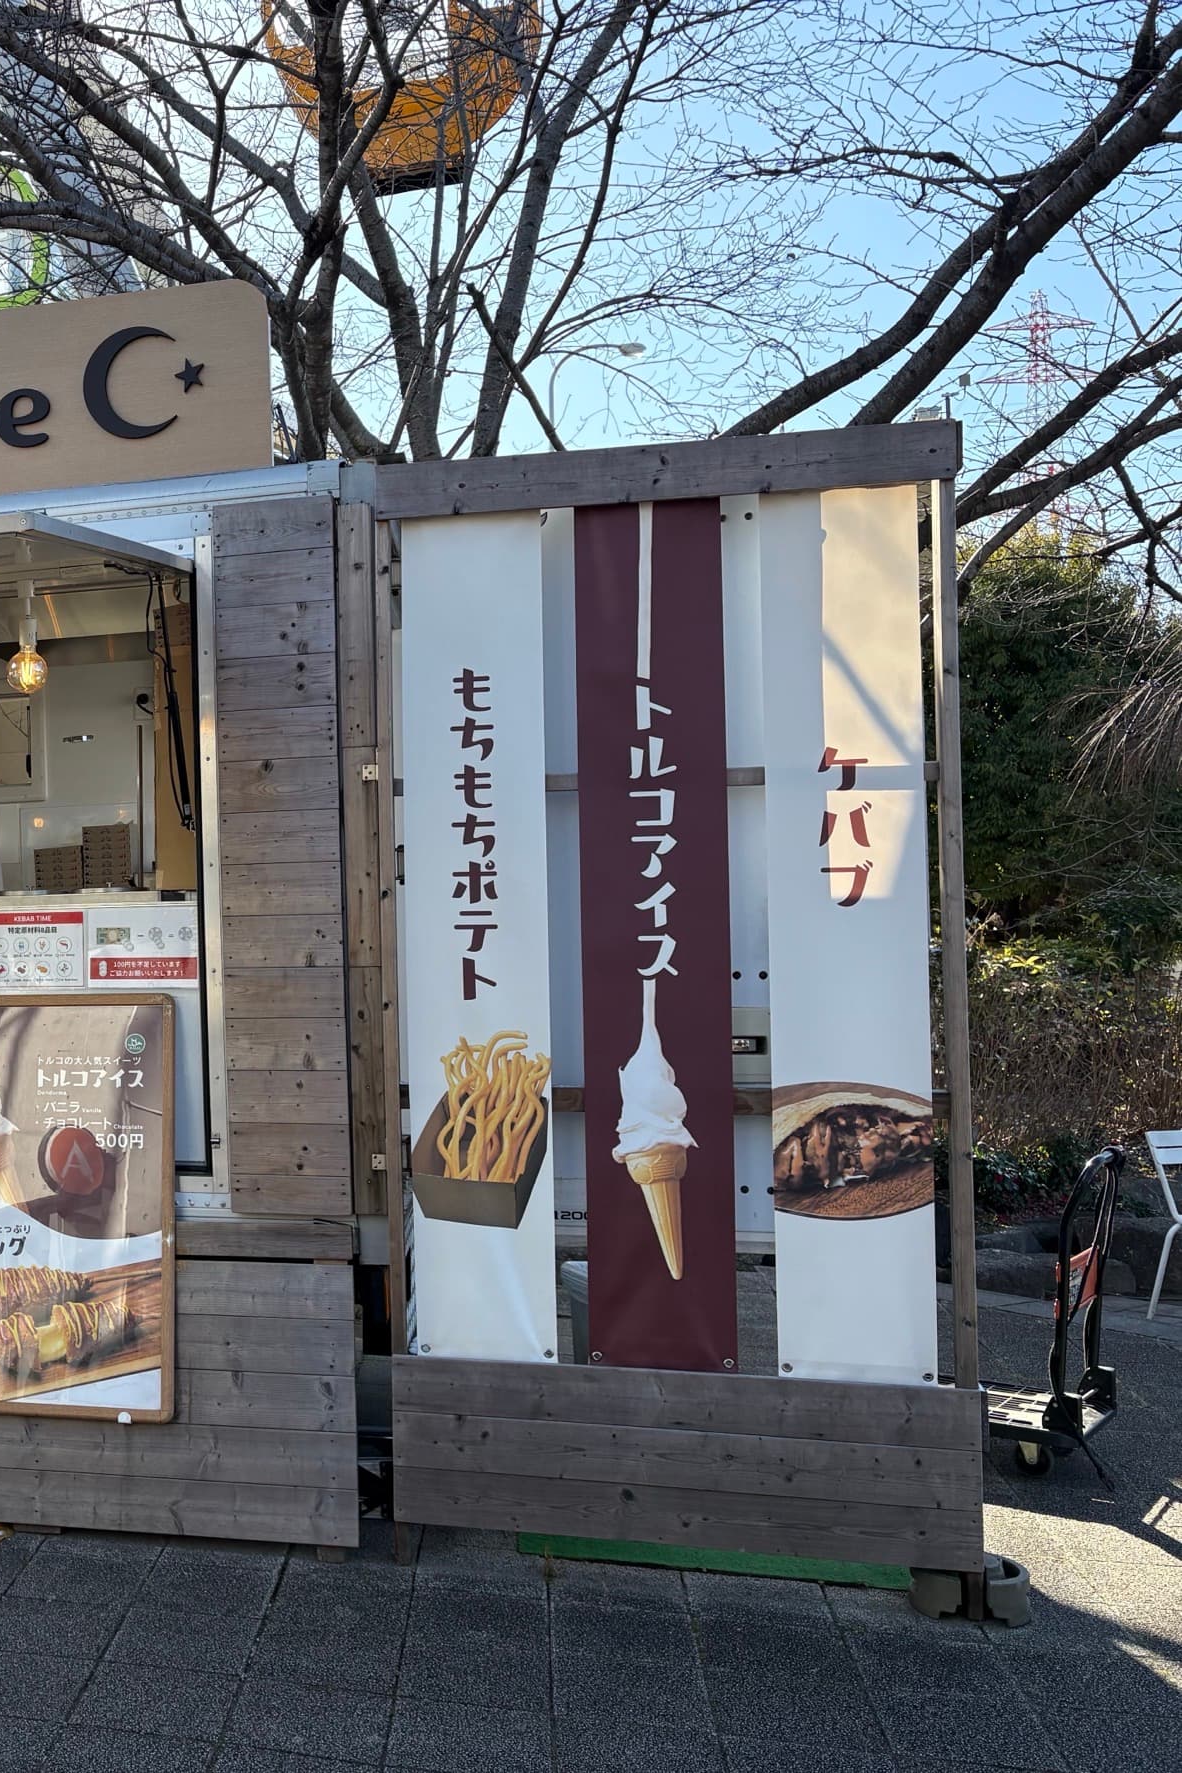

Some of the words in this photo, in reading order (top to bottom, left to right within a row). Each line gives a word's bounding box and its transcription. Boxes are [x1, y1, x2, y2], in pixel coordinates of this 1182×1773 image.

[450, 668, 499, 1001] もちもちポテト
[629, 685, 679, 977] トルコアイス
[817, 746, 874, 908] ケバブ
[37, 1056, 142, 1066] トルコの大人気スイーツ
[37, 1069, 144, 1088] トルコアイス
[95, 1133, 144, 1149] 500円
